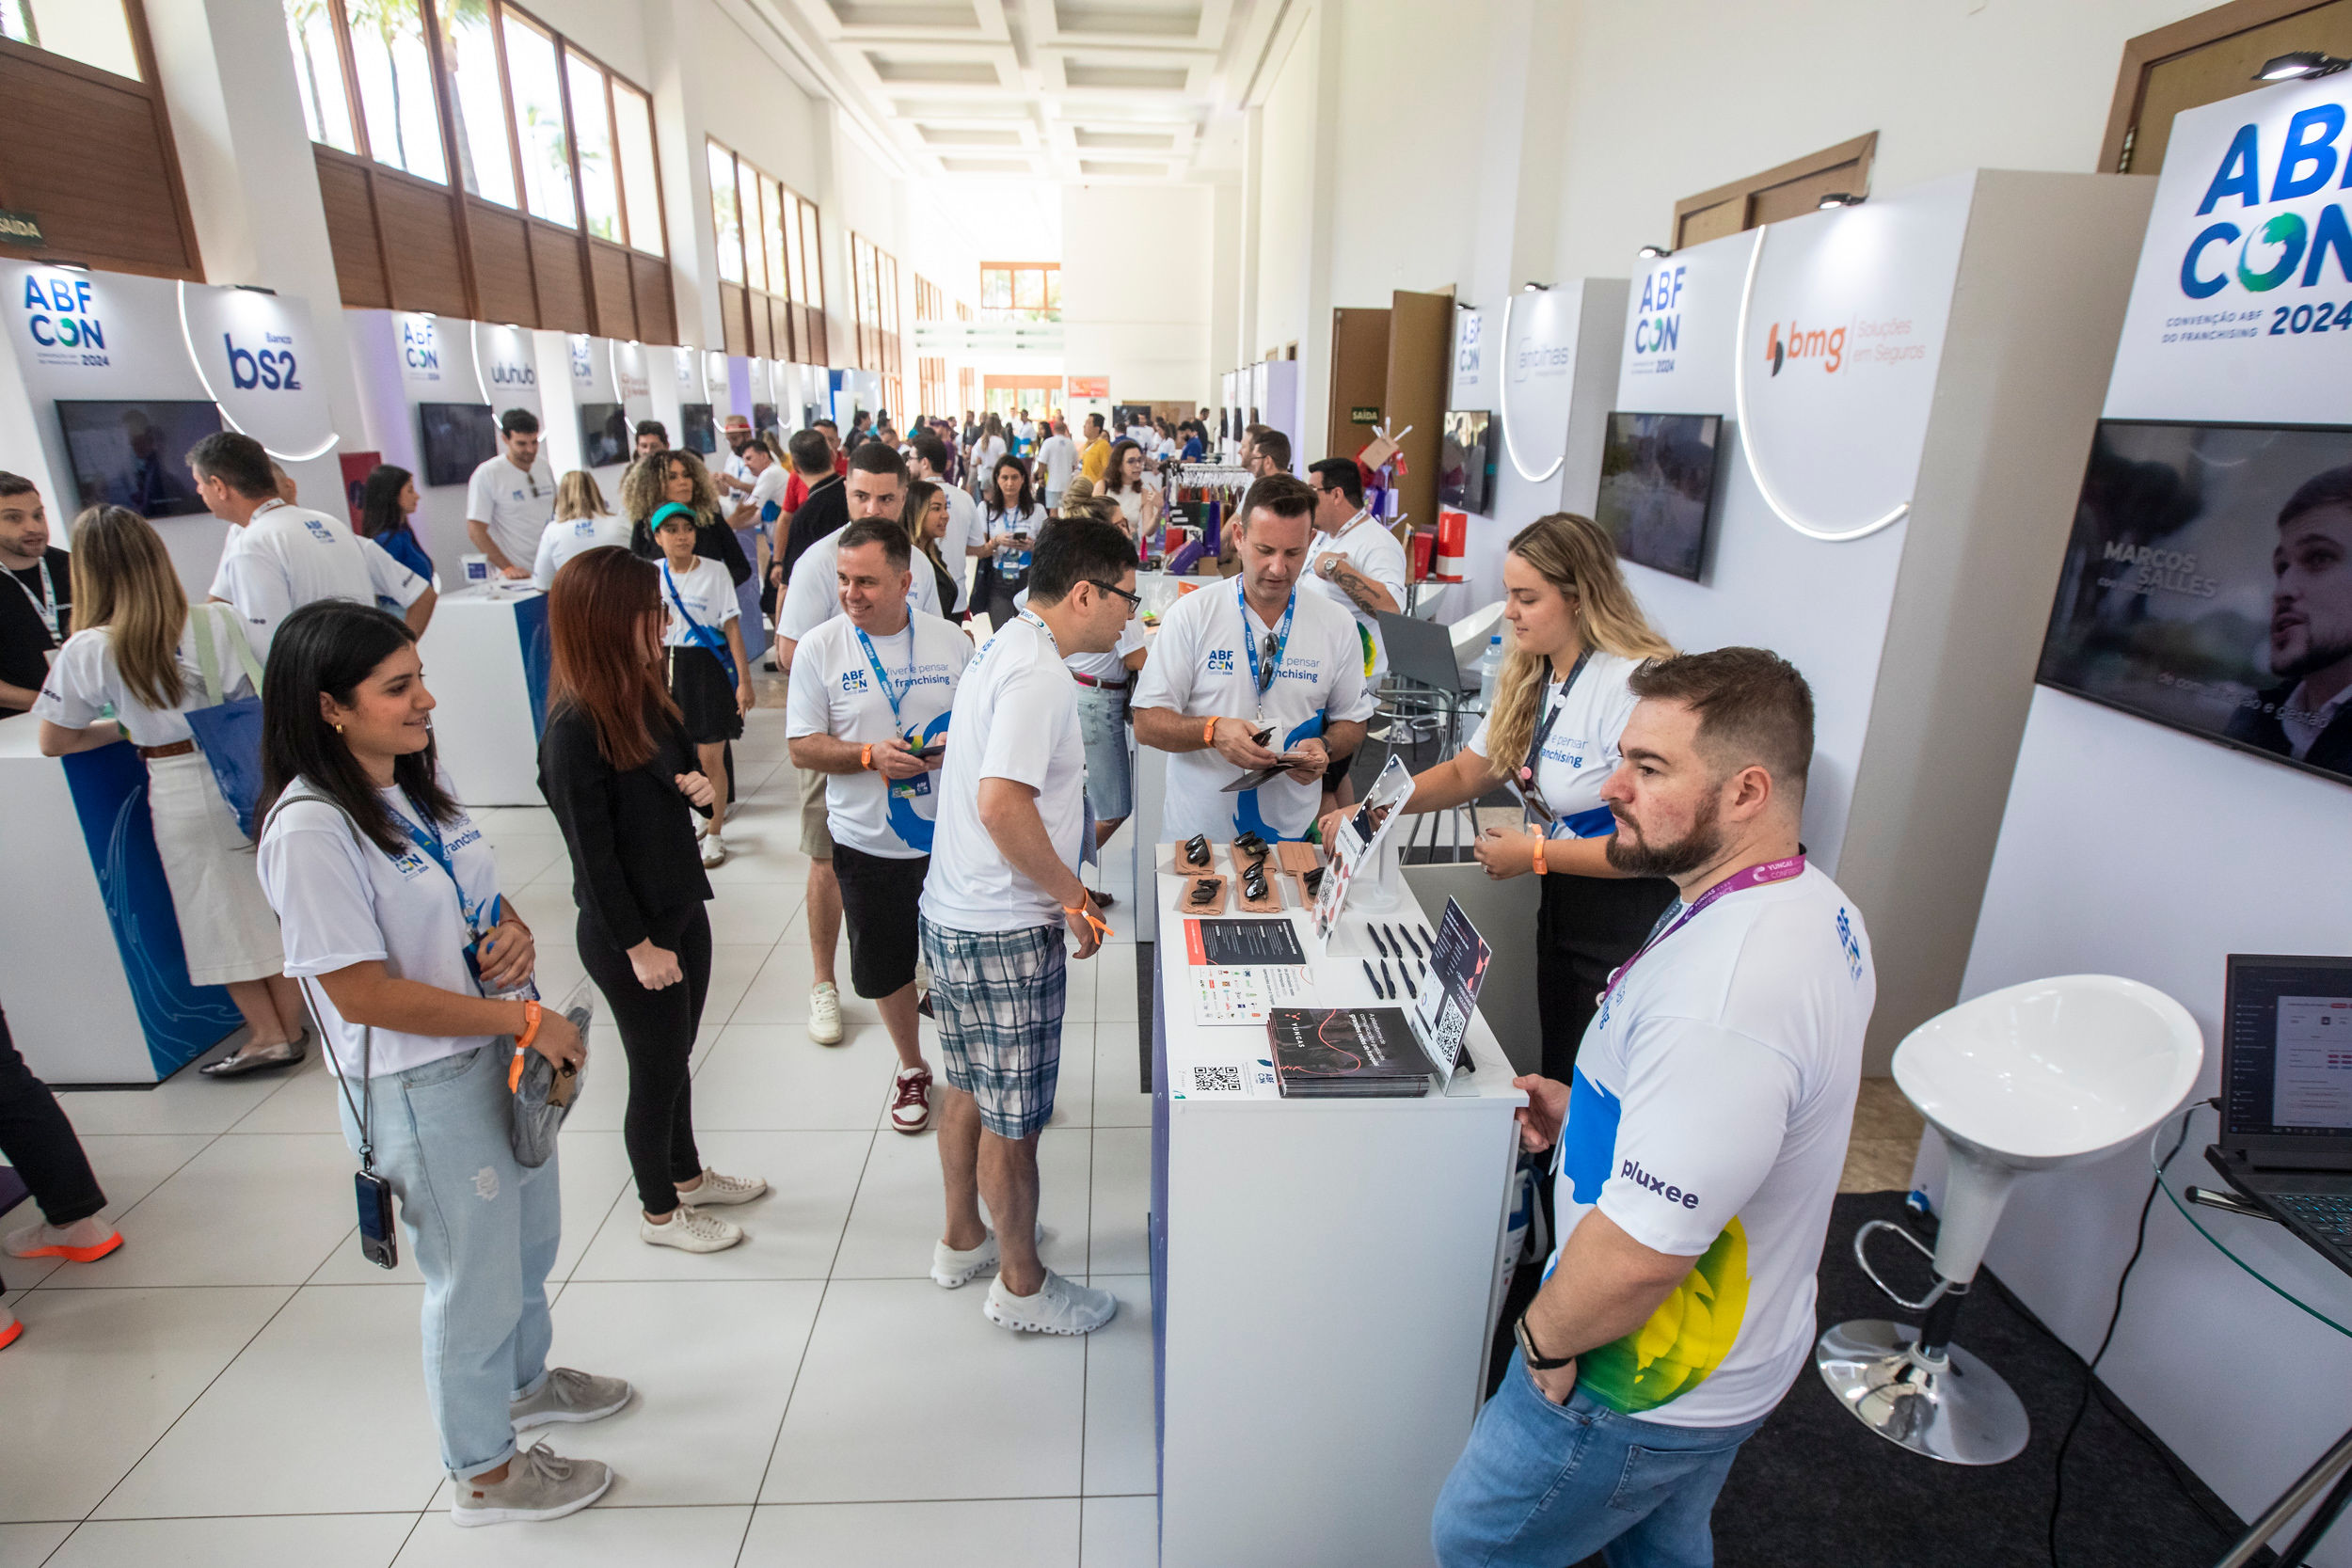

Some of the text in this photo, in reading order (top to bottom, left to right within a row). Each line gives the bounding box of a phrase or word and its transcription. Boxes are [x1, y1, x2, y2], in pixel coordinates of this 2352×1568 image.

[2194, 103, 2352, 217] AB
[24, 275, 91, 314] ABF
[1639, 265, 1687, 314] ABF
[1858, 317, 1913, 341] Soluções
[2166, 309, 2264, 327] CONVENÇÃO ABF
[2268, 300, 2352, 336] 2024
[30, 314, 106, 350] CON
[1635, 313, 1681, 355] CON
[2161, 327, 2258, 343] DO FRANCHISING
[1787, 320, 1847, 373] bmg
[1853, 343, 1927, 366] em Seguros
[81, 354, 110, 367] 2024
[223, 332, 302, 390] bs2
[2104, 540, 2198, 575] MARCOS
[2138, 564, 2218, 598] SALLES
[1208, 660, 1233, 671] CON
[1209, 650, 1233, 660] ABF
[1286, 657, 1320, 668] pensar
[841, 669, 865, 682] ABF
[918, 663, 948, 673] pensar
[1276, 669, 1318, 683] nchising
[843, 679, 867, 691] CON
[1557, 736, 1588, 749] pensar
[1541, 748, 1583, 768] anchising
[394, 853, 423, 874] CON
[1767, 860, 1793, 871] YUNGAS
[1291, 1022, 1306, 1048] YUNGAS
[1620, 1158, 1700, 1211] pluxee
